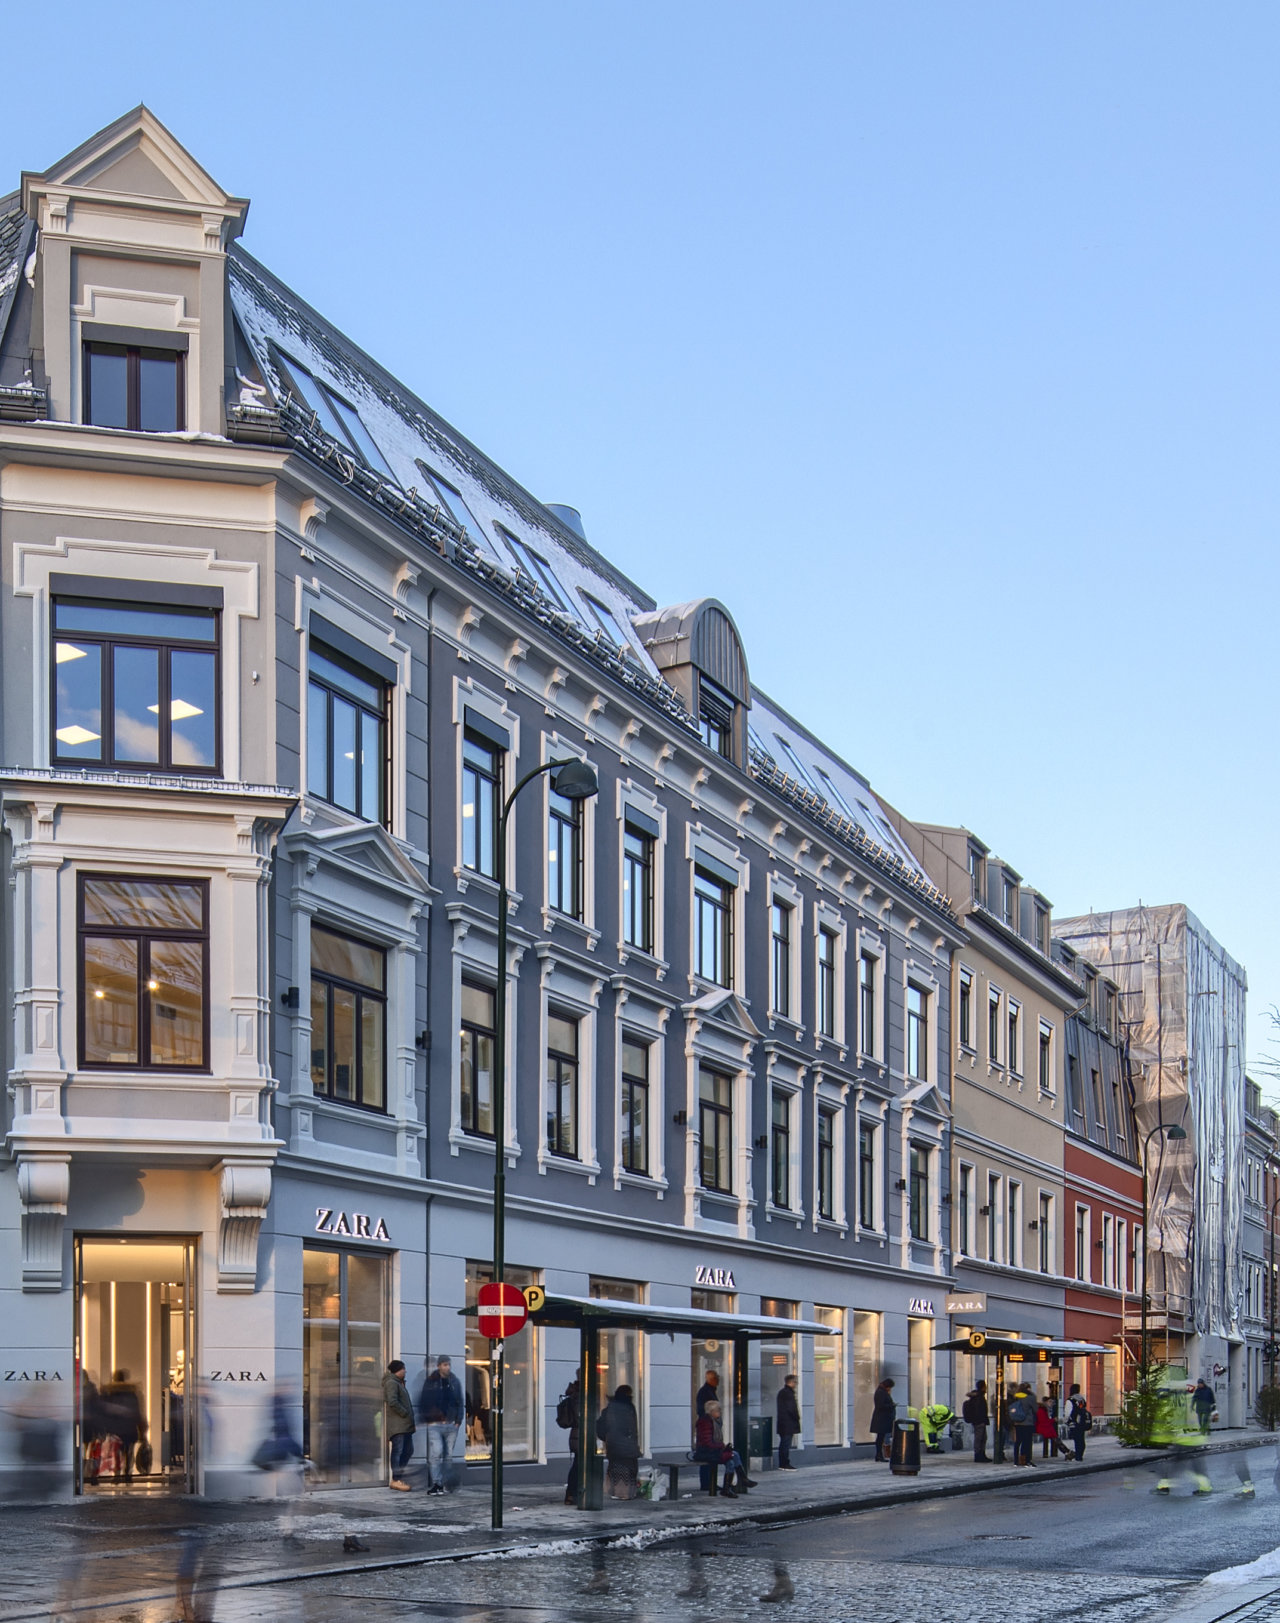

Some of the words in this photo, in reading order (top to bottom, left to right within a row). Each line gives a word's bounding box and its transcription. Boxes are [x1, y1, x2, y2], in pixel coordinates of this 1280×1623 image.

[315, 1207, 392, 1242] ZARA
[695, 1265, 736, 1288] ZARA
[528, 1290, 539, 1307] P
[909, 1298, 935, 1315] ZARA
[947, 1302, 984, 1310] ZARA
[974, 1335, 982, 1345] P
[4, 1370, 64, 1381] ZARA
[210, 1371, 268, 1382] ZARA
